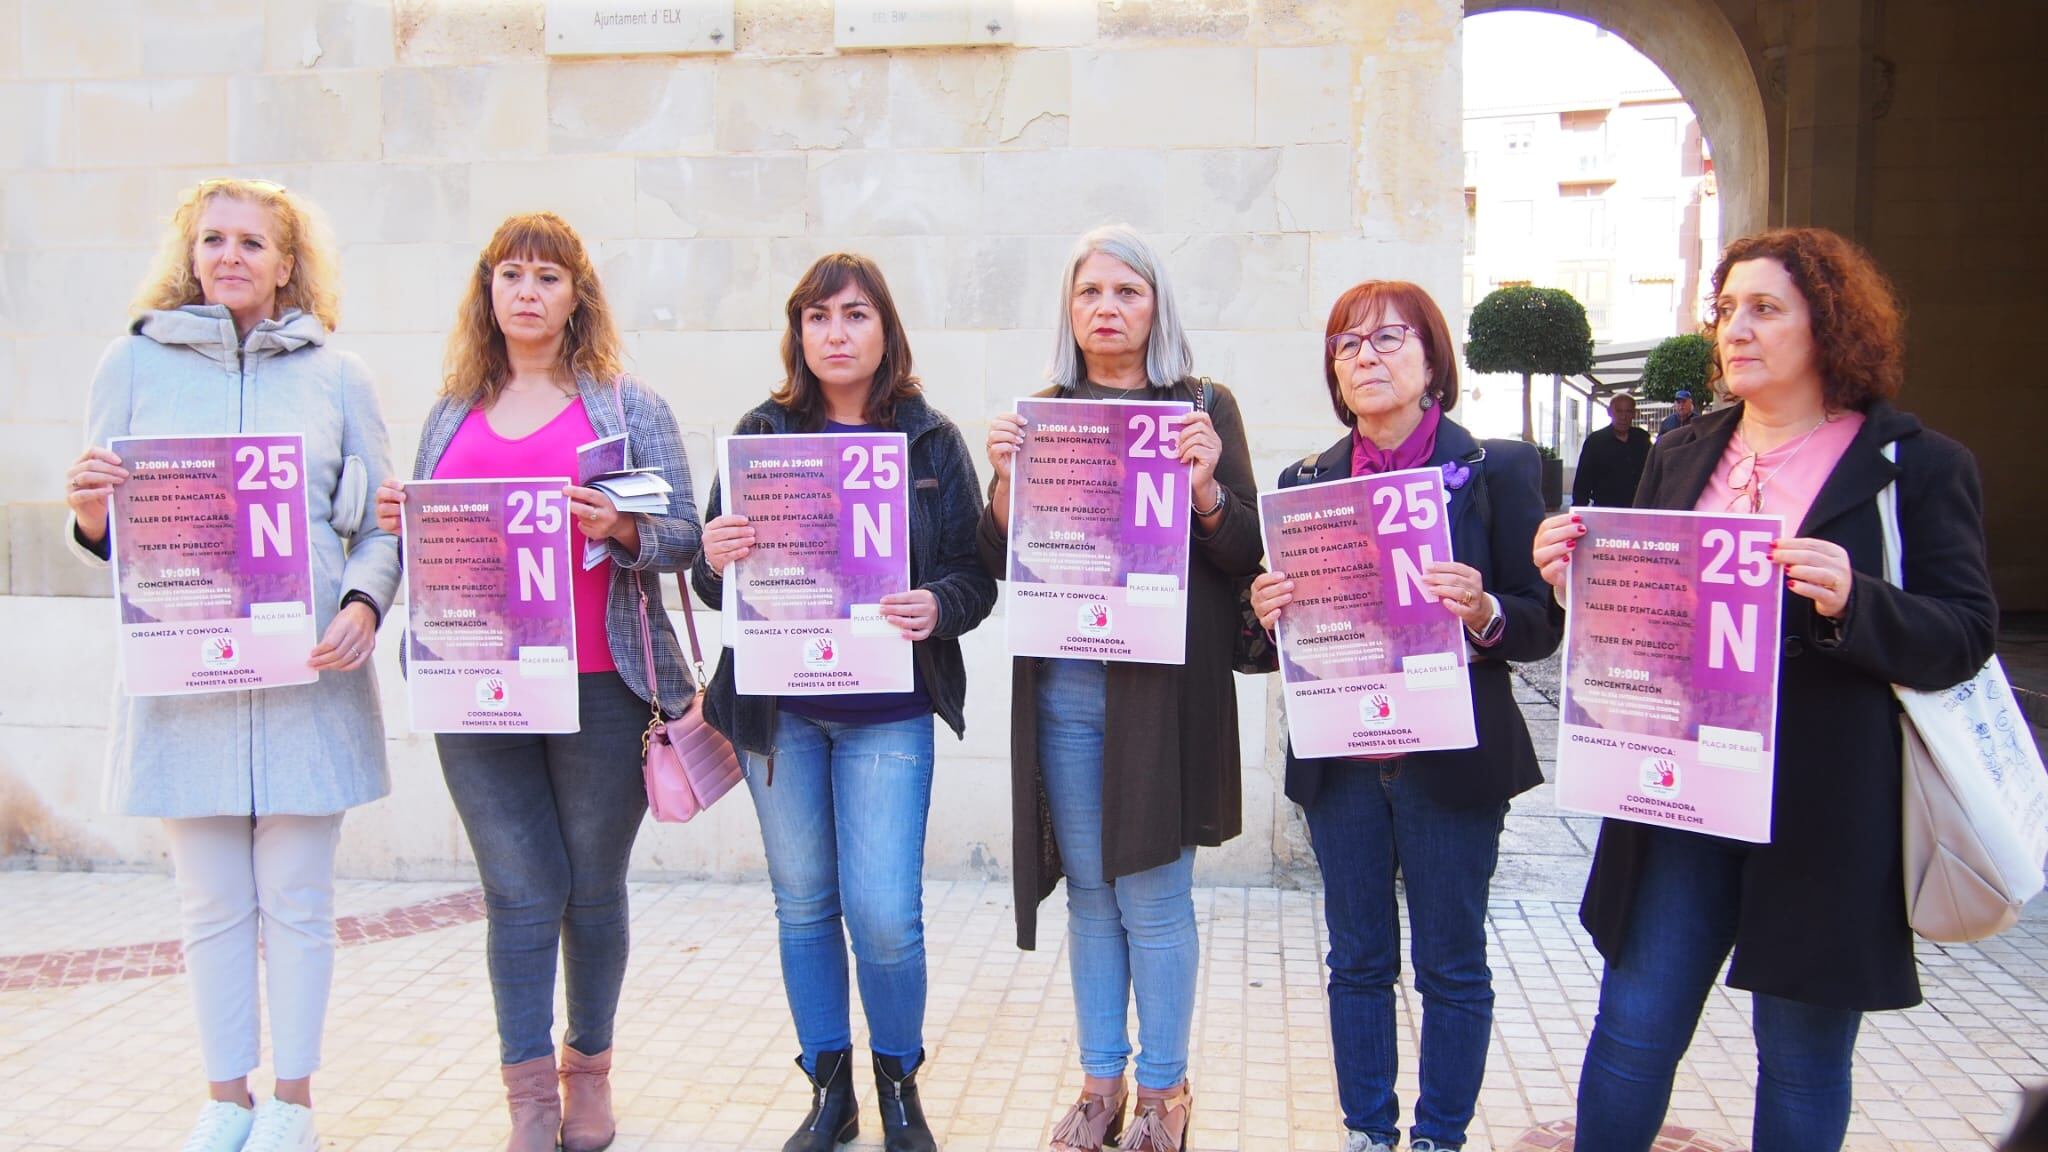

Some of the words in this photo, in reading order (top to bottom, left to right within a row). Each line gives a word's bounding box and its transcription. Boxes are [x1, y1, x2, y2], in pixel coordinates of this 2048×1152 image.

[594, 11, 647, 29] Ajuntament
[1037, 424, 1067, 432] 17:00H
[1069, 424, 1076, 432] A
[1078, 424, 1109, 433] 19:00H
[1057, 436, 1110, 444] INFORMATIVA
[1127, 414, 1184, 459] 25
[135, 460, 169, 469] 17:00H
[170, 460, 179, 468] A
[180, 459, 215, 468] 19:00H
[235, 445, 299, 490] 25
[749, 459, 779, 468] 17:00H
[782, 459, 789, 467] A
[791, 458, 823, 467] 19:00H
[841, 444, 900, 490] 25
[158, 472, 217, 480] INFORMATIVA
[770, 471, 824, 479] INFORMATIVA
[1067, 479, 1117, 487] PINTACARAS
[174, 493, 226, 501] PANCARTAS
[1134, 471, 1174, 527] N
[422, 504, 450, 513] 17:00H
[451, 504, 458, 512] A
[459, 503, 488, 512] 19:00H
[506, 490, 562, 534] 25
[1372, 479, 1438, 536] 25
[174, 514, 229, 522] PINTACARAS
[441, 515, 491, 523] INFORMATIVA
[1282, 511, 1312, 524] 17:00H
[1313, 510, 1321, 519] A
[1322, 505, 1354, 518] 19:00H
[248, 502, 292, 557] N
[851, 502, 892, 557] N
[1281, 526, 1302, 536] MESA
[1304, 518, 1357, 532] INFORMATIVA
[1049, 530, 1085, 540] 19:00H
[1280, 548, 1307, 558] TALLER
[1308, 546, 1319, 554] DE
[1321, 539, 1368, 553] PANCARTAS
[1595, 538, 1629, 549] 17:00H
[1632, 540, 1640, 549] A
[1642, 540, 1679, 551] 19:00H
[1592, 553, 1615, 561] MESA
[1618, 554, 1680, 565] INFORMATIVA
[1700, 528, 1773, 587] 25
[160, 567, 200, 578] 19:00H
[517, 547, 556, 601] N
[768, 566, 805, 576] 19:00H
[1285, 569, 1310, 580] ALLER
[1310, 568, 1320, 576] DE
[1322, 561, 1373, 575] PINTACARAS
[1390, 543, 1439, 606] N
[1586, 577, 1616, 586] TALLER
[1619, 579, 1631, 587] DE
[1633, 580, 1687, 592] PANCARTAS
[1017, 590, 1058, 598] ORGANIZA
[1066, 592, 1108, 601] CONVOCA:
[442, 609, 476, 618] 19:00H
[1585, 602, 1614, 611] TALLER
[1616, 604, 1627, 612] DE
[1629, 606, 1688, 618] PINTACARAS
[131, 629, 177, 638] ORGANIZA
[186, 626, 232, 635] CONVOCA:
[1315, 620, 1352, 633] 19:00H
[1066, 636, 1125, 645] COORDINADORA
[1708, 600, 1758, 672] N
[1059, 645, 1097, 653] FEMINISTA
[191, 668, 255, 678] COORDINADORA
[1608, 666, 1649, 681] 19:00H
[185, 679, 226, 687] FEMINISTA
[1295, 687, 1336, 696] ORGANIZA
[1344, 682, 1387, 693] CONVOCA:
[1352, 728, 1412, 738] COORDINADORA
[1347, 739, 1385, 748] FEMINISTA
[1397, 737, 1420, 745] ELCHE
[1571, 734, 1617, 747] ORGANIZA
[1627, 741, 1676, 756] CONVOCA:
[1627, 794, 1695, 812] COORDINADORA
[1619, 804, 1662, 818] FEMINISTA
[1665, 811, 1675, 820] DE
[1677, 814, 1703, 825] ELCHE
